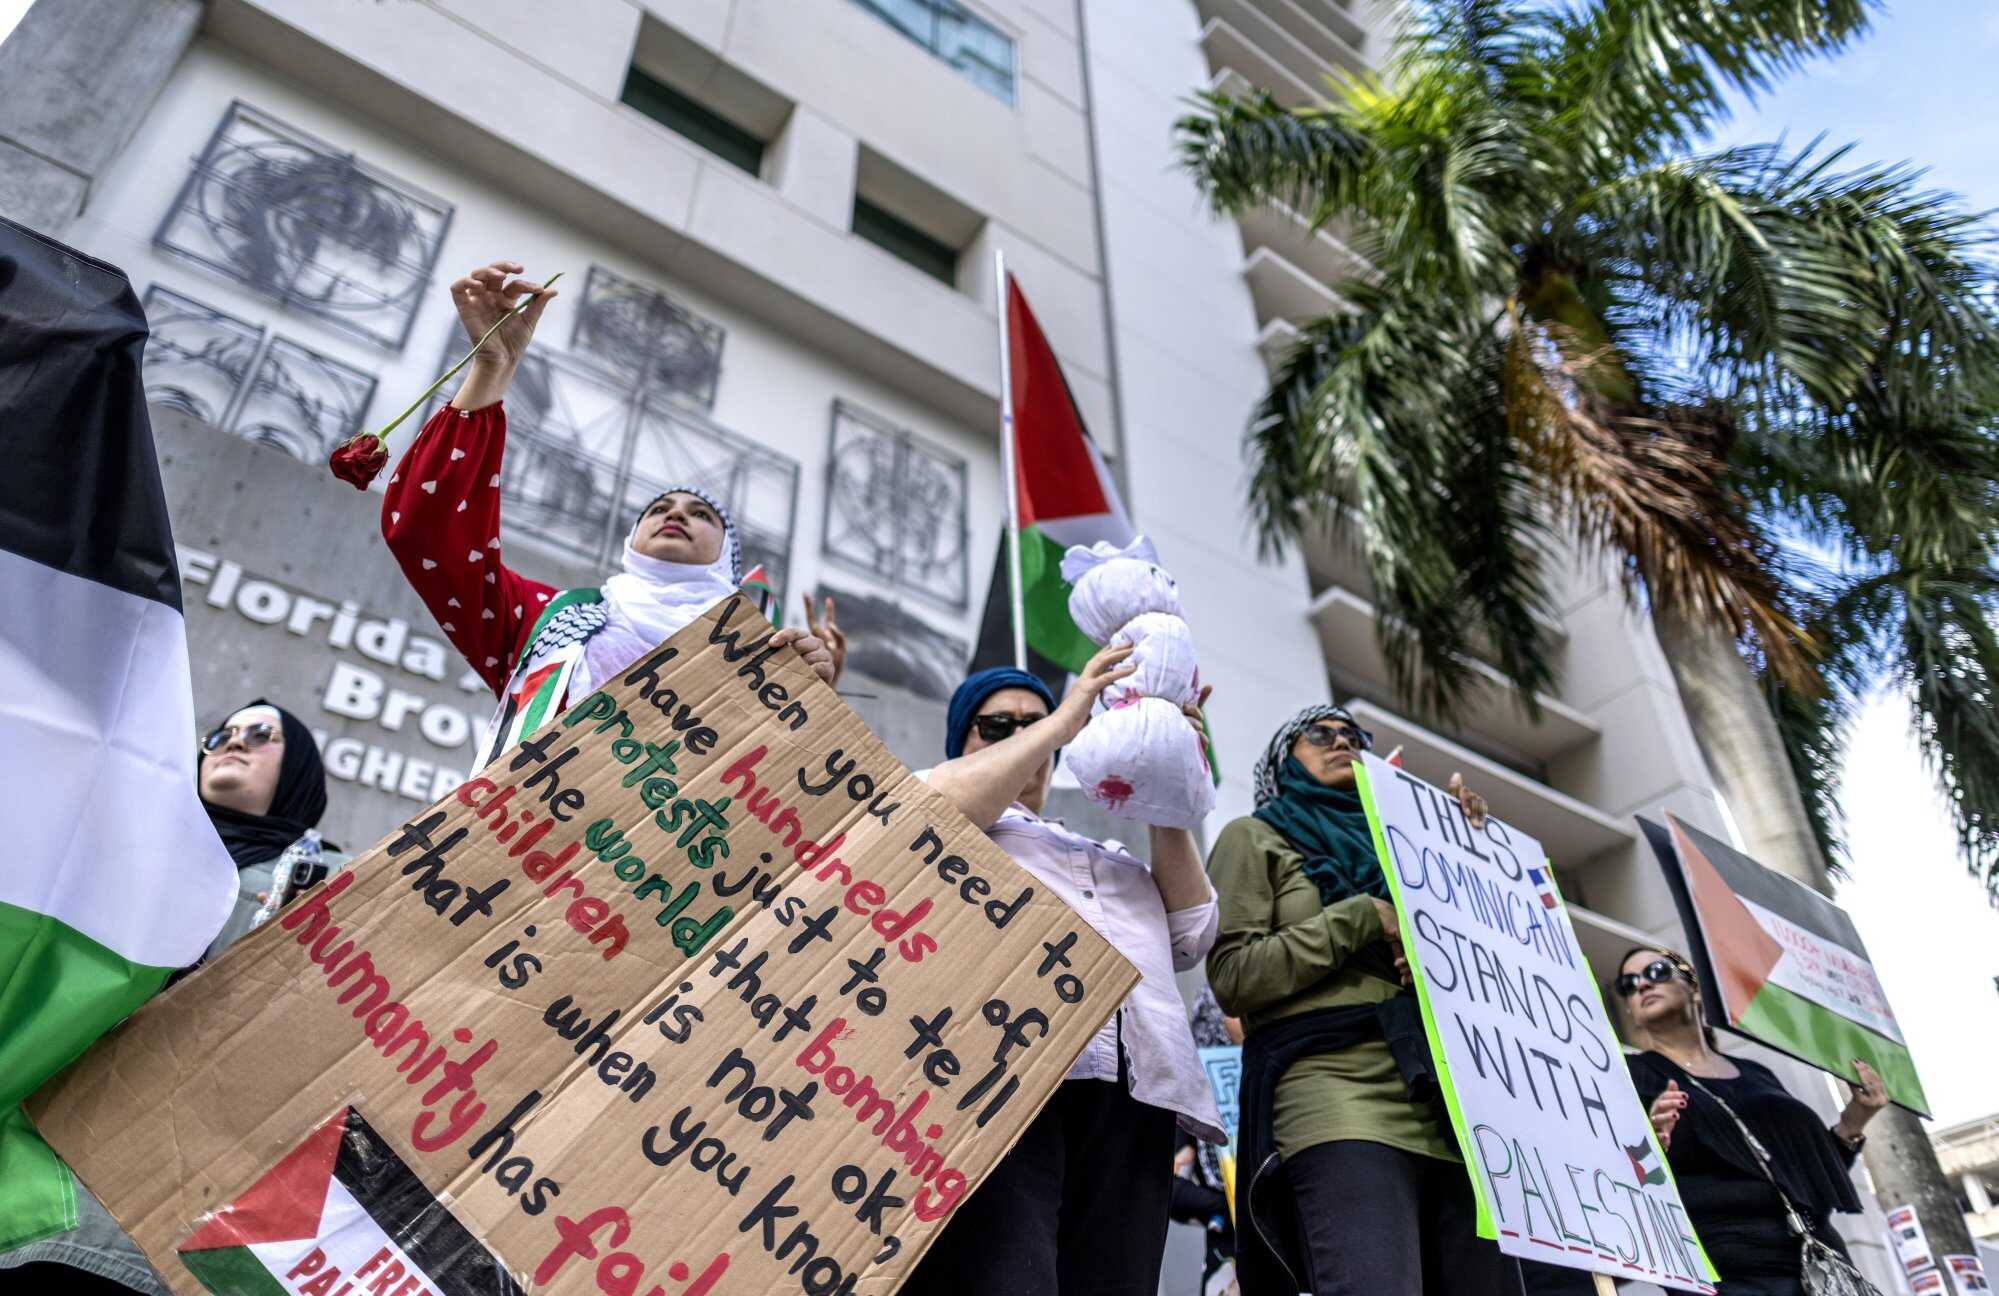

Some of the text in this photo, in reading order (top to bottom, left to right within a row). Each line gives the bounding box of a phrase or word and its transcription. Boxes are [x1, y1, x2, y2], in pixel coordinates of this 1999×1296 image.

[322, 659, 489, 752] Bro
[623, 647, 1050, 1063] have hundreds of
[708, 597, 1085, 1004] When you need to
[1394, 770, 1523, 882] THIS
[280, 869, 498, 1153] humanity
[467, 1089, 561, 1216] has
[386, 810, 874, 1296] that is when you kno
[456, 776, 631, 962] children
[642, 980, 705, 1044] is
[705, 1047, 819, 1142] not
[509, 730, 968, 1223] the world that bombing
[561, 690, 1021, 1129] protests just to tell
[1386, 824, 1577, 971] DOMINICAN
[1412, 907, 1612, 1073] STANDS
[1455, 1012, 1622, 1150] WITH
[1472, 1123, 1715, 1288] PALESTINE
